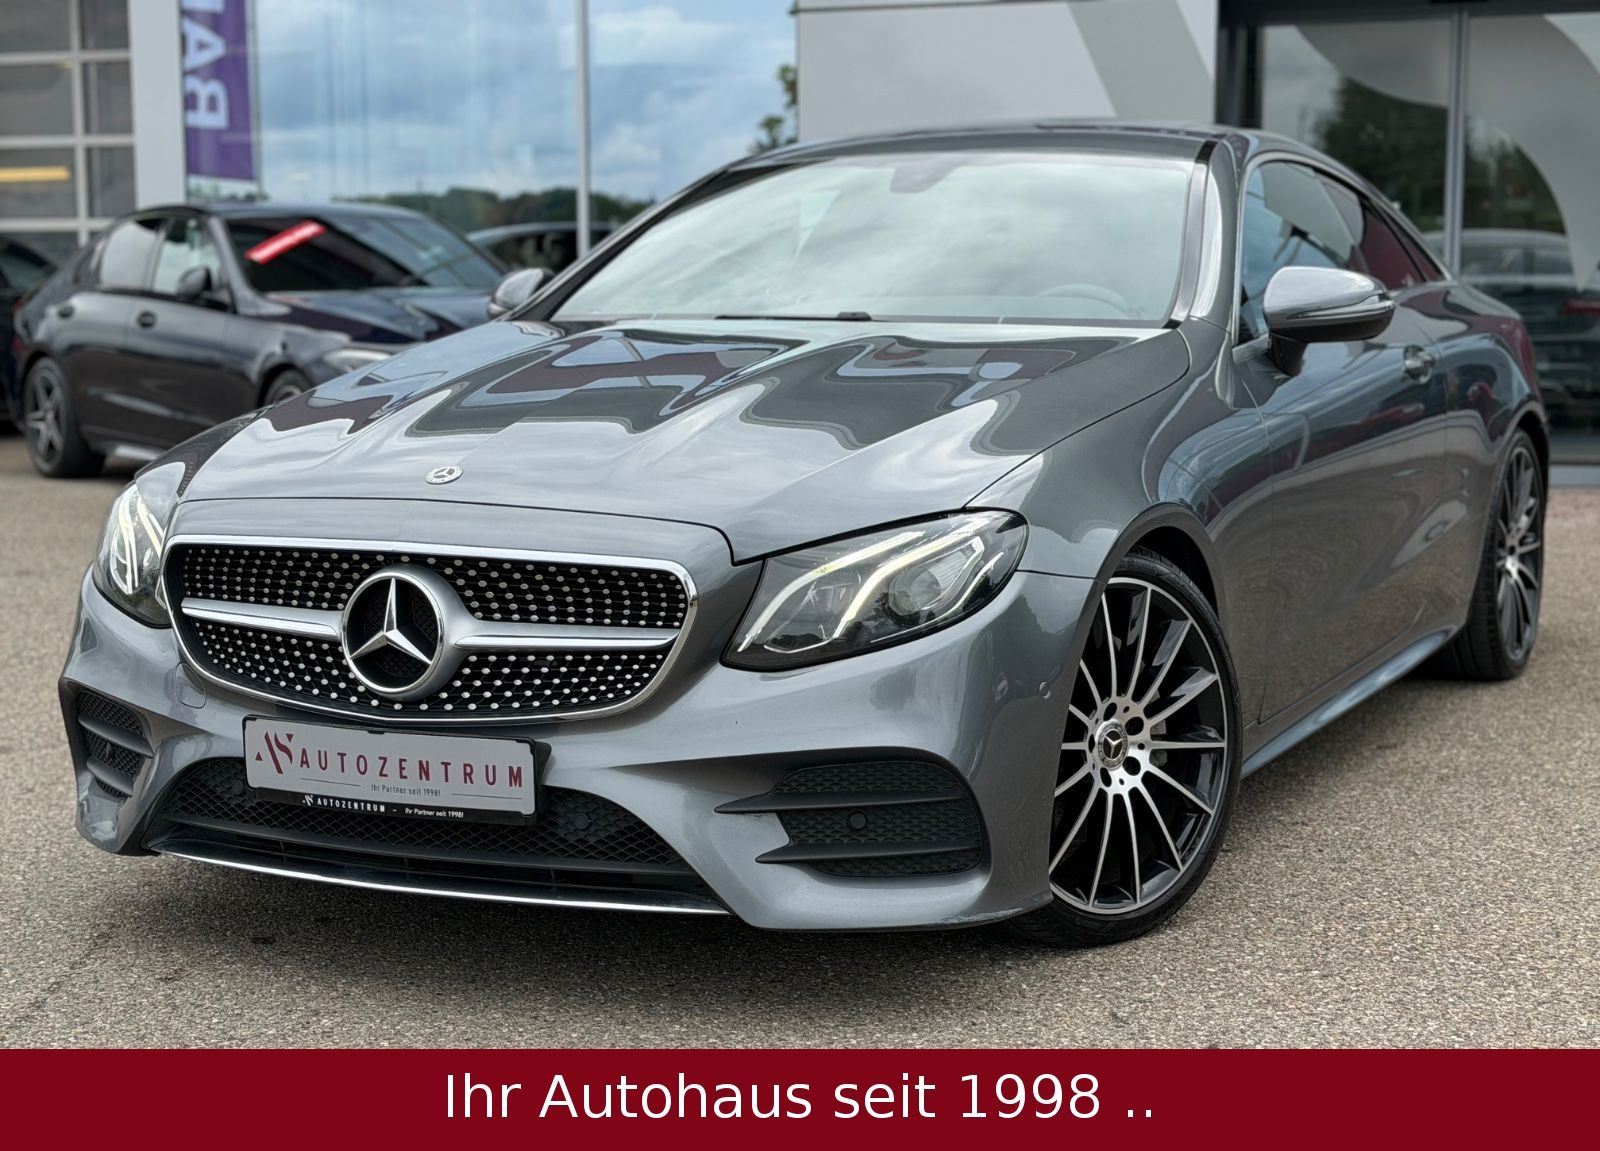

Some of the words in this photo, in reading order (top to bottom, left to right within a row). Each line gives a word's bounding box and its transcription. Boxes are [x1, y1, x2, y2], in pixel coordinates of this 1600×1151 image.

[300, 747, 523, 788] AUTOZENTRUM
[371, 783, 380, 791] Ihr
[381, 784, 406, 794] Partner
[408, 787, 421, 796] seit
[317, 798, 386, 813] AUTOZENTRUM
[413, 808, 435, 816] Partner
